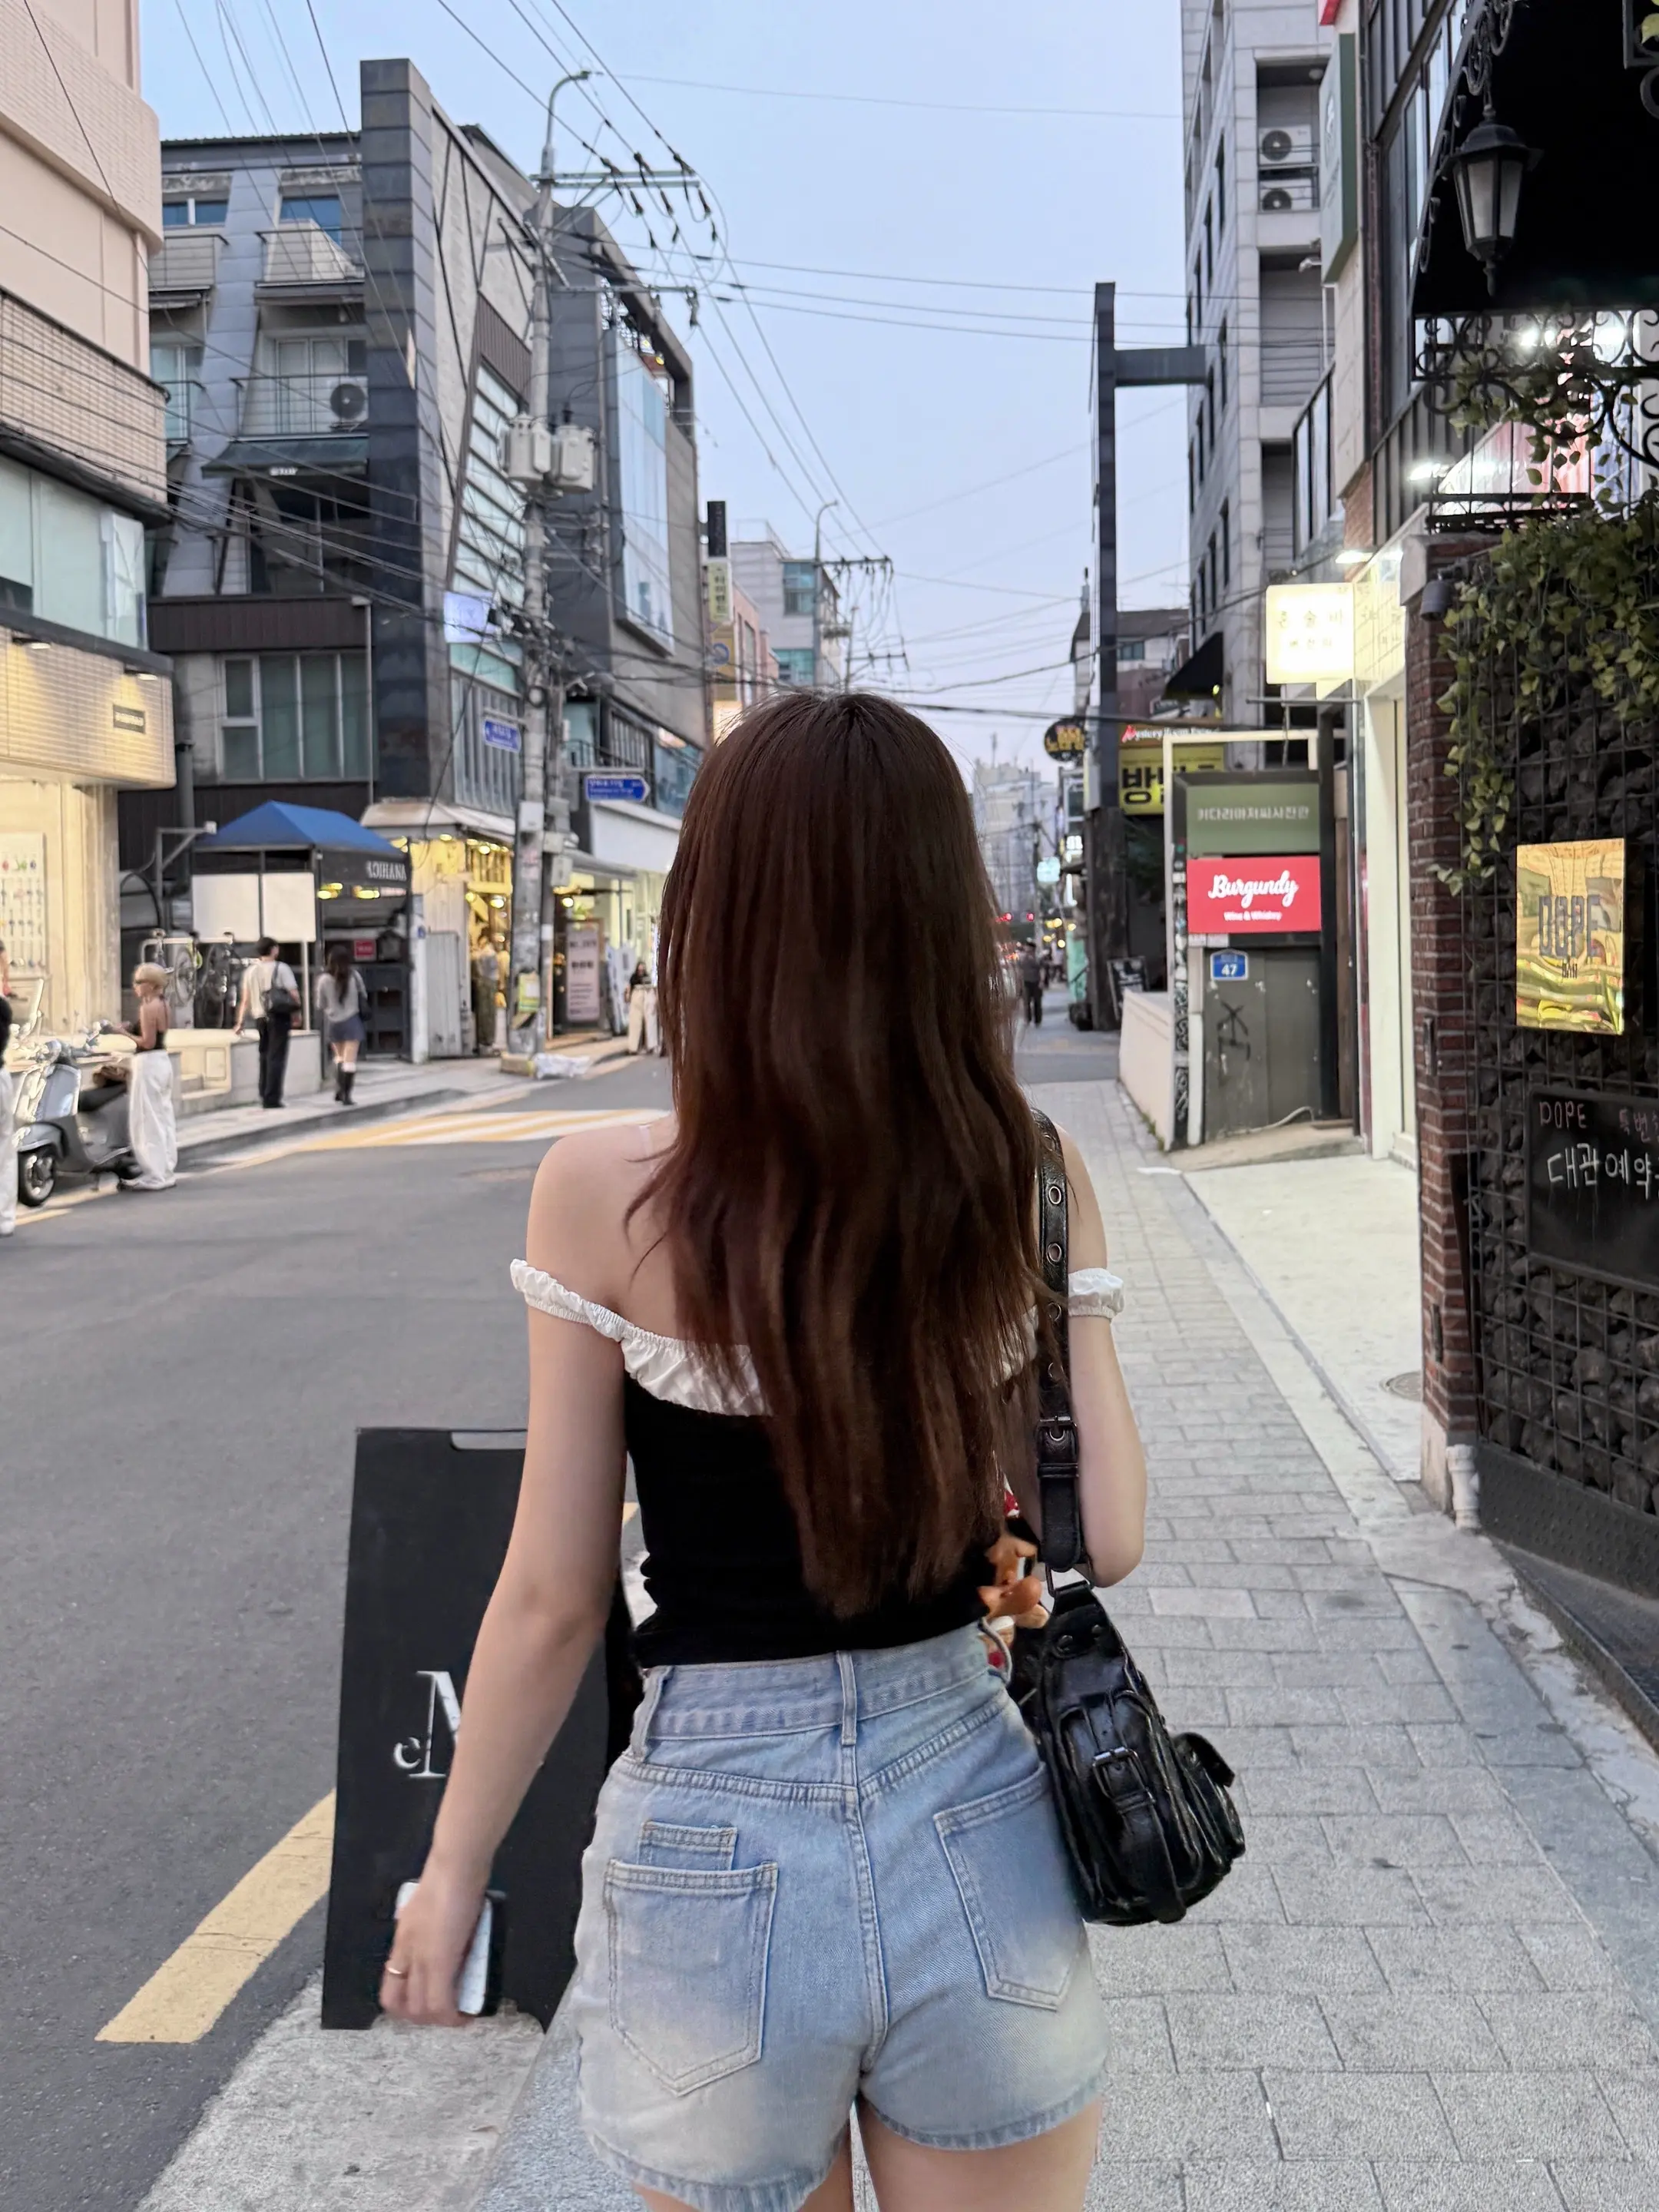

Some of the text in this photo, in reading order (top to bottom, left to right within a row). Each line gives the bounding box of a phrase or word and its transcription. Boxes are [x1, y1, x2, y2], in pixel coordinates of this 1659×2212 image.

[1207, 870, 1299, 909] Burgundy
[1538, 894, 1601, 959] DOPE
[1221, 963, 1237, 976] 47
[1539, 1101, 1588, 1130] DOPE
